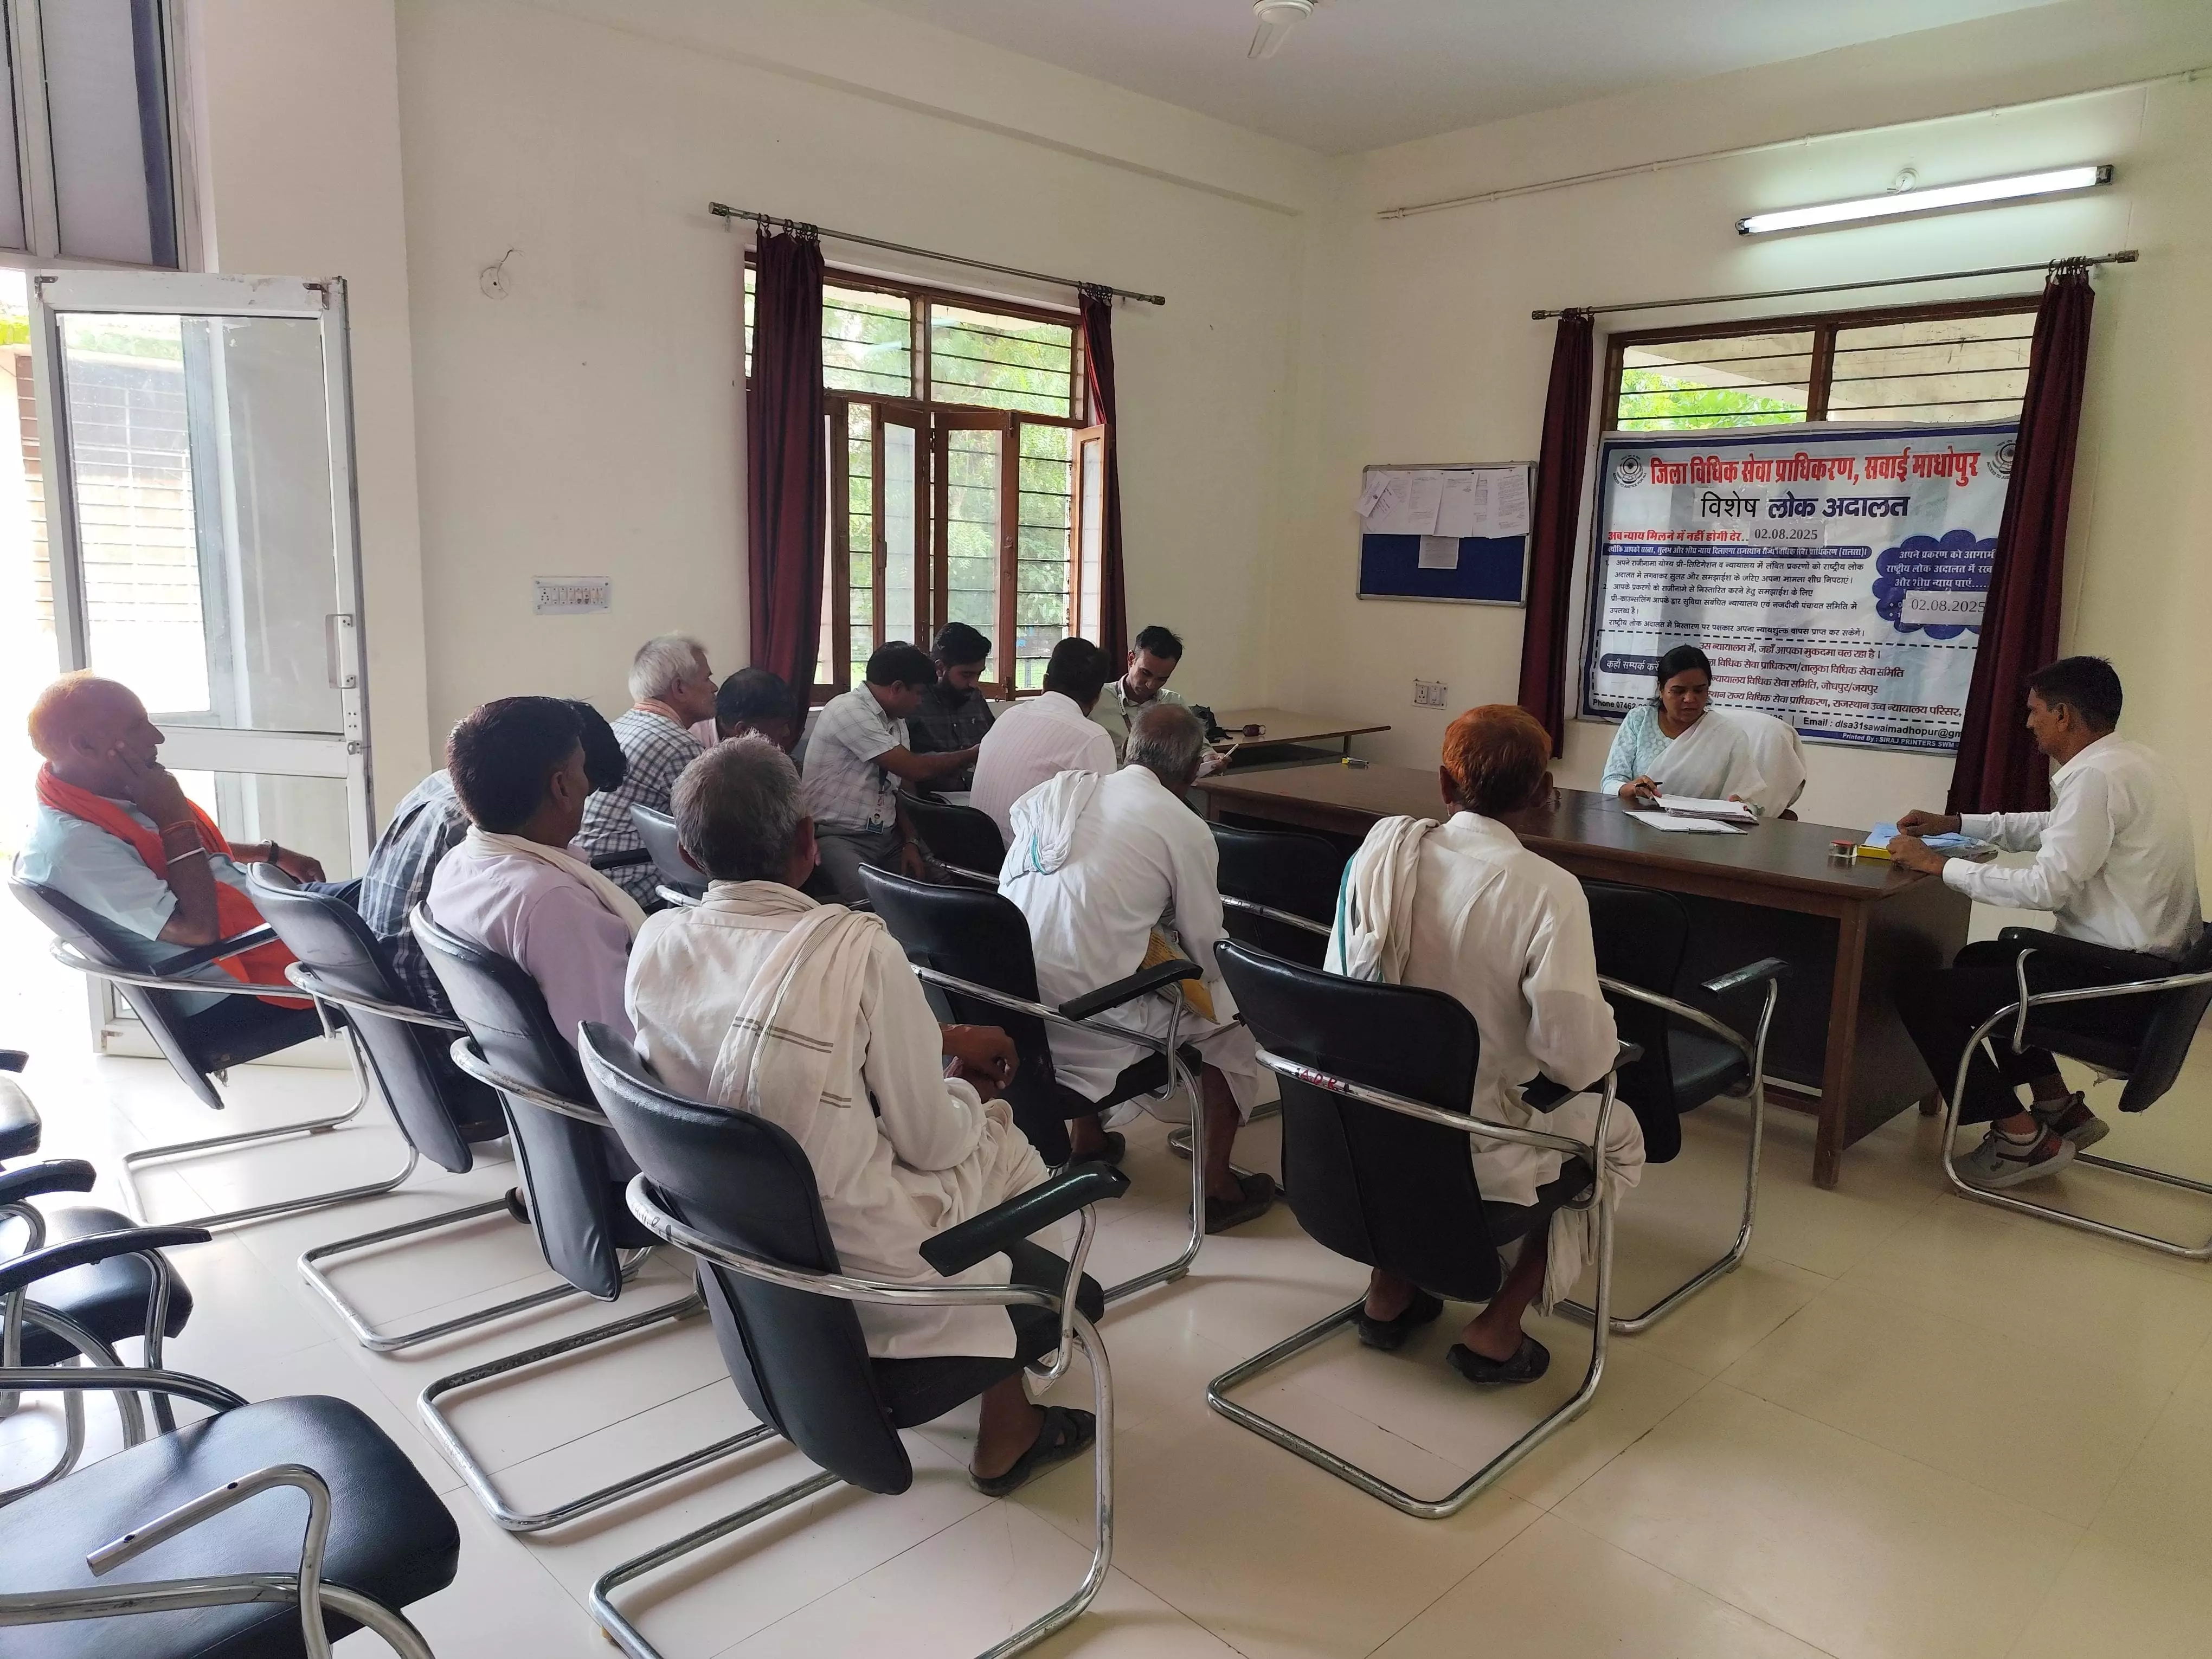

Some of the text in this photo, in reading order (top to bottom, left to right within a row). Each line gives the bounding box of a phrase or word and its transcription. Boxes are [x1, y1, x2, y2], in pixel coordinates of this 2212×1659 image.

[1651, 446, 1981, 487] जिला विधिक सेवा प्राधिकरण, सवाई माधोपुर
[1701, 491, 1911, 518] विशेष लोक अदालत
[1608, 531, 1622, 541] अब
[1624, 532, 1645, 541] न्याय
[1647, 530, 1674, 541] मिलने
[1676, 530, 1686, 541] में
[1687, 530, 1705, 541] नहीं
[1706, 530, 1727, 542] होगी
[1754, 529, 1818, 539] 02.08.2025
[1899, 550, 1920, 558] अपने
[1921, 551, 1947, 559] प्रकरण
[1950, 550, 1963, 558] को
[1616, 558, 1630, 566] अपने
[1658, 558, 1674, 567] योग्य
[1676, 560, 1716, 568] प्री-लिटिगेशन
[1787, 561, 1810, 569] प्रकरणों
[1812, 561, 1821, 570] को
[1823, 562, 1846, 572] राष्ट्रीय
[1848, 561, 1864, 570] लोक
[1887, 564, 1911, 575] राष्ट्रीय
[1912, 564, 1931, 573] लोक
[1968, 564, 1976, 573] में
[1978, 565, 1992, 574] रख
[1687, 571, 1699, 580] और
[1701, 572, 1732, 582] समझाईश
[1742, 574, 1759, 582] जरिए
[1895, 577, 1911, 587] और
[1662, 584, 1687, 593] राजीनामे
[1689, 584, 1694, 593] से
[1697, 584, 1726, 593] निस्तारित
[1728, 586, 1744, 594] करने
[1746, 587, 1756, 596] हेतु
[1758, 588, 1789, 596] समझाईश
[1791, 587, 1797, 596] के
[1799, 588, 1814, 596] लिए
[1652, 596, 1669, 604] आपके
[1683, 598, 1702, 607] सुविधा
[1773, 601, 1799, 609] नजदीकी
[1911, 599, 1986, 613] 02.08.2025
[1609, 619, 1627, 628] राष्ट्रीय
[1674, 621, 1700, 629] निस्तारण
[1712, 643, 1746, 651] न्यायालय
[1776, 647, 1803, 655] आपका
[1804, 648, 1836, 658] मुकदमा
[1854, 650, 1867, 658] रहा
[1607, 658, 1621, 668] कहाँ
[1623, 659, 1646, 671] सम्पर्क
[1718, 657, 1741, 667] विधिक
[1744, 659, 1759, 668] सेवा
[1831, 664, 1856, 674] विधिक
[1859, 666, 1875, 676] सेवा
[1877, 666, 1905, 678] समिति
[1747, 676, 1772, 685] विधिक
[1773, 677, 1790, 687] सेवा
[1593, 699, 1615, 707] Phone
[1746, 691, 1771, 702] विधिक
[1773, 693, 1789, 703] सेवा
[1833, 699, 1870, 709] राजस्थान
[1887, 704, 1927, 714] न्यायालय
[1803, 717, 1828, 725] Email
